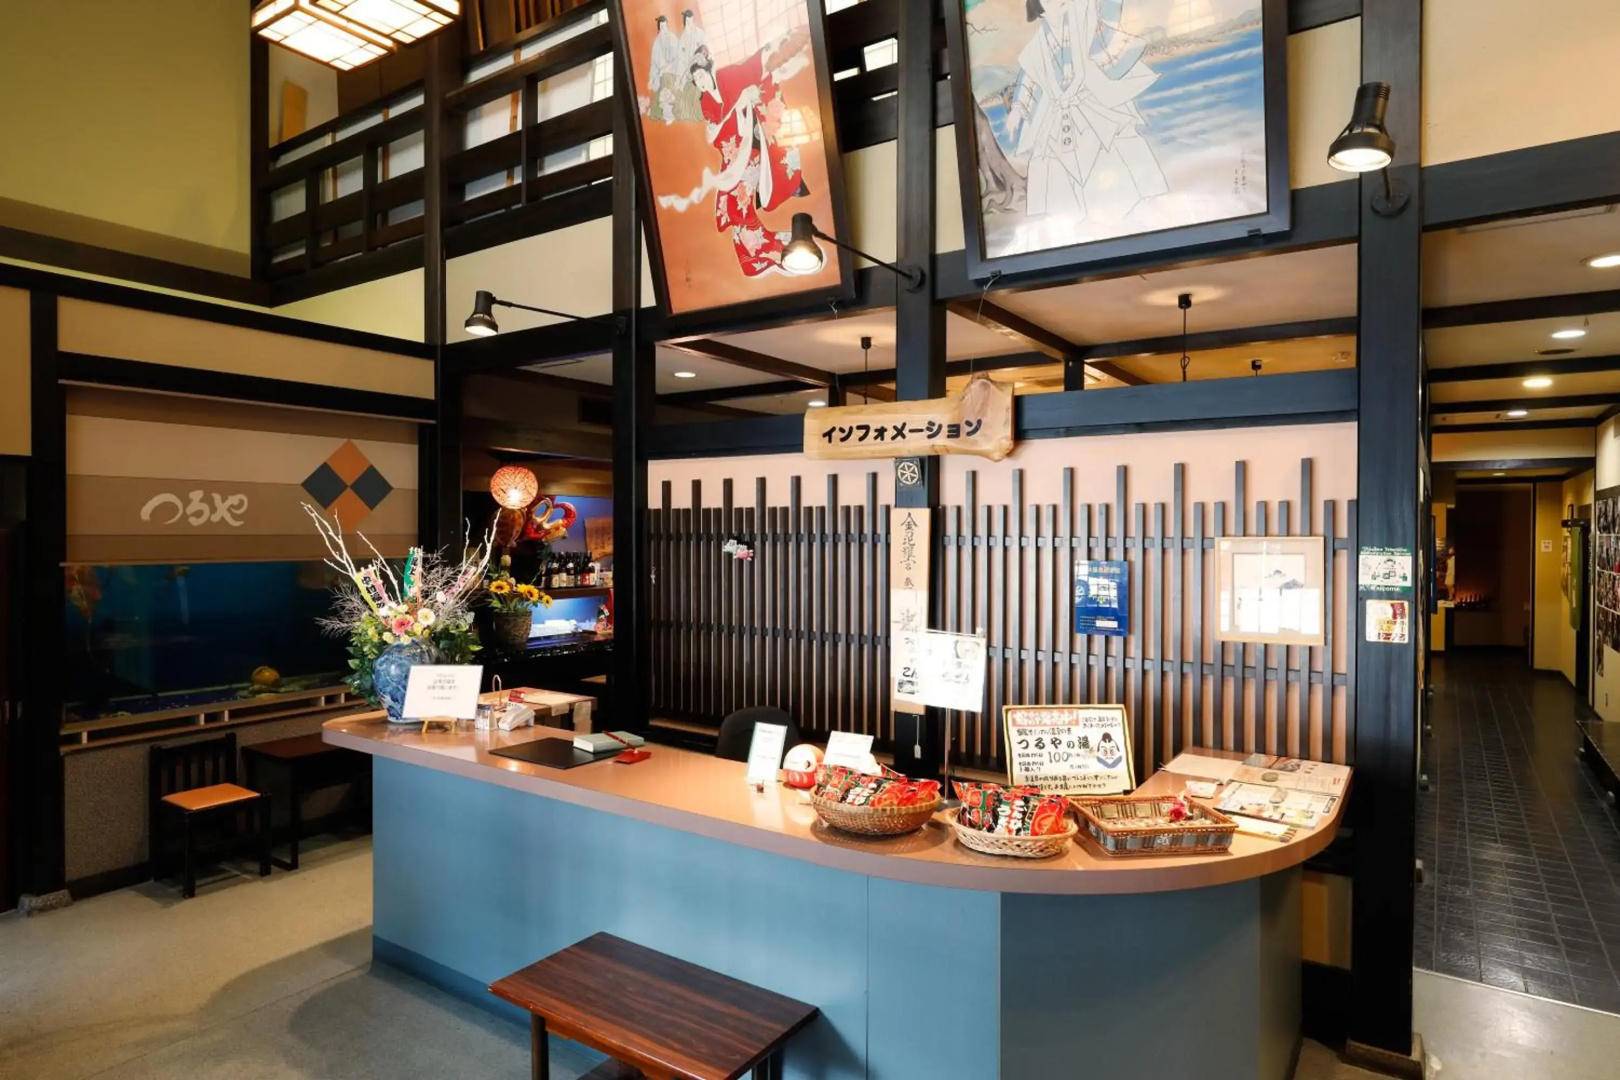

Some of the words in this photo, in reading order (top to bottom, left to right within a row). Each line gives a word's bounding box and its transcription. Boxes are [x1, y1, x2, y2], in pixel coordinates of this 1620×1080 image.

[822, 419, 982, 443] インフォメーション
[140, 490, 248, 526] つるや
[1016, 736, 1090, 750] つるやの湯
